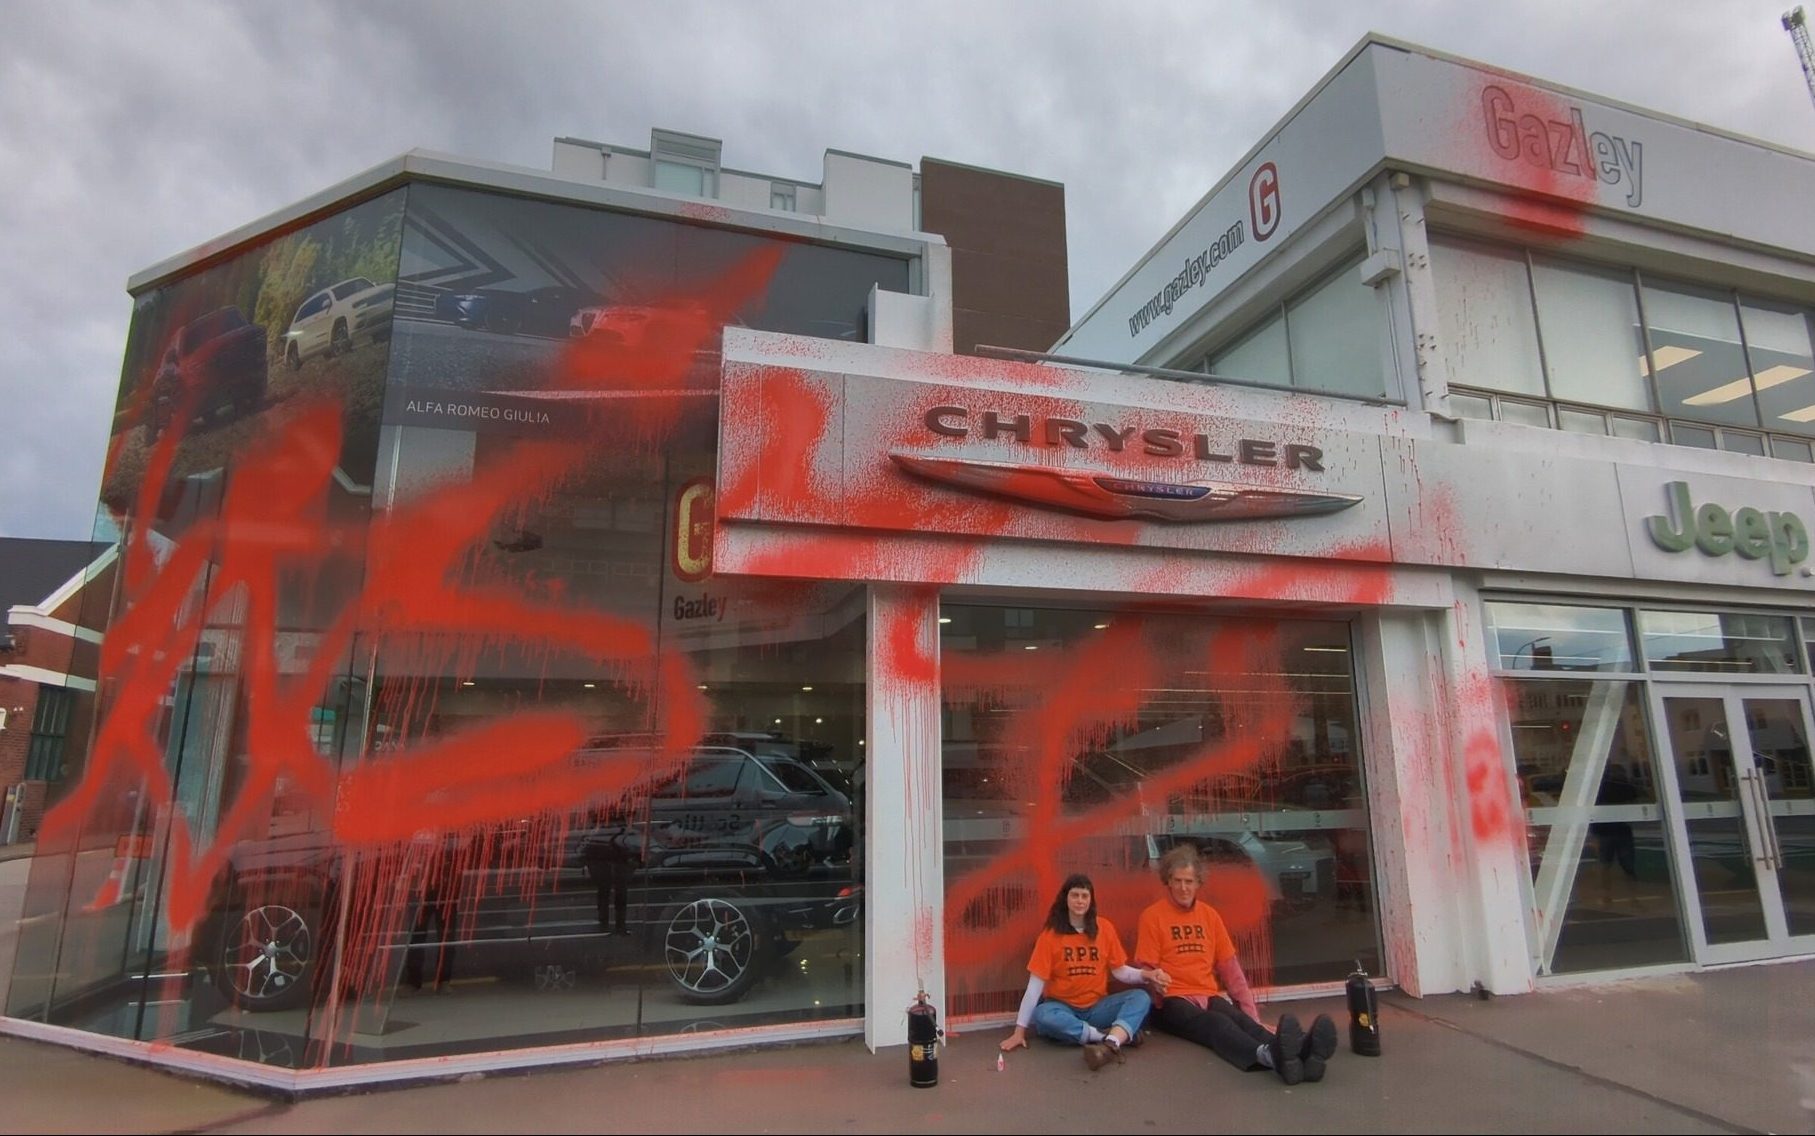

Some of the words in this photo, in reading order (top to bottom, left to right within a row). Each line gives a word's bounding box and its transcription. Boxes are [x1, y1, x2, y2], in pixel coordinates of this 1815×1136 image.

[1482, 85, 1643, 208] Gazley
[1250, 164, 1280, 240] G
[1128, 220, 1244, 337] www.gazley.com
[406, 400, 443, 414] ALFA
[447, 403, 500, 419] ROMEO
[503, 408, 550, 423] GIULIA
[924, 405, 1325, 472] CHRYSLER
[1112, 483, 1194, 496] CHRYSLER
[1643, 481, 1809, 576] Jeep
[674, 593, 726, 621] Gazley
[1064, 946, 1099, 961] RPR
[1171, 925, 1205, 940] RPR
